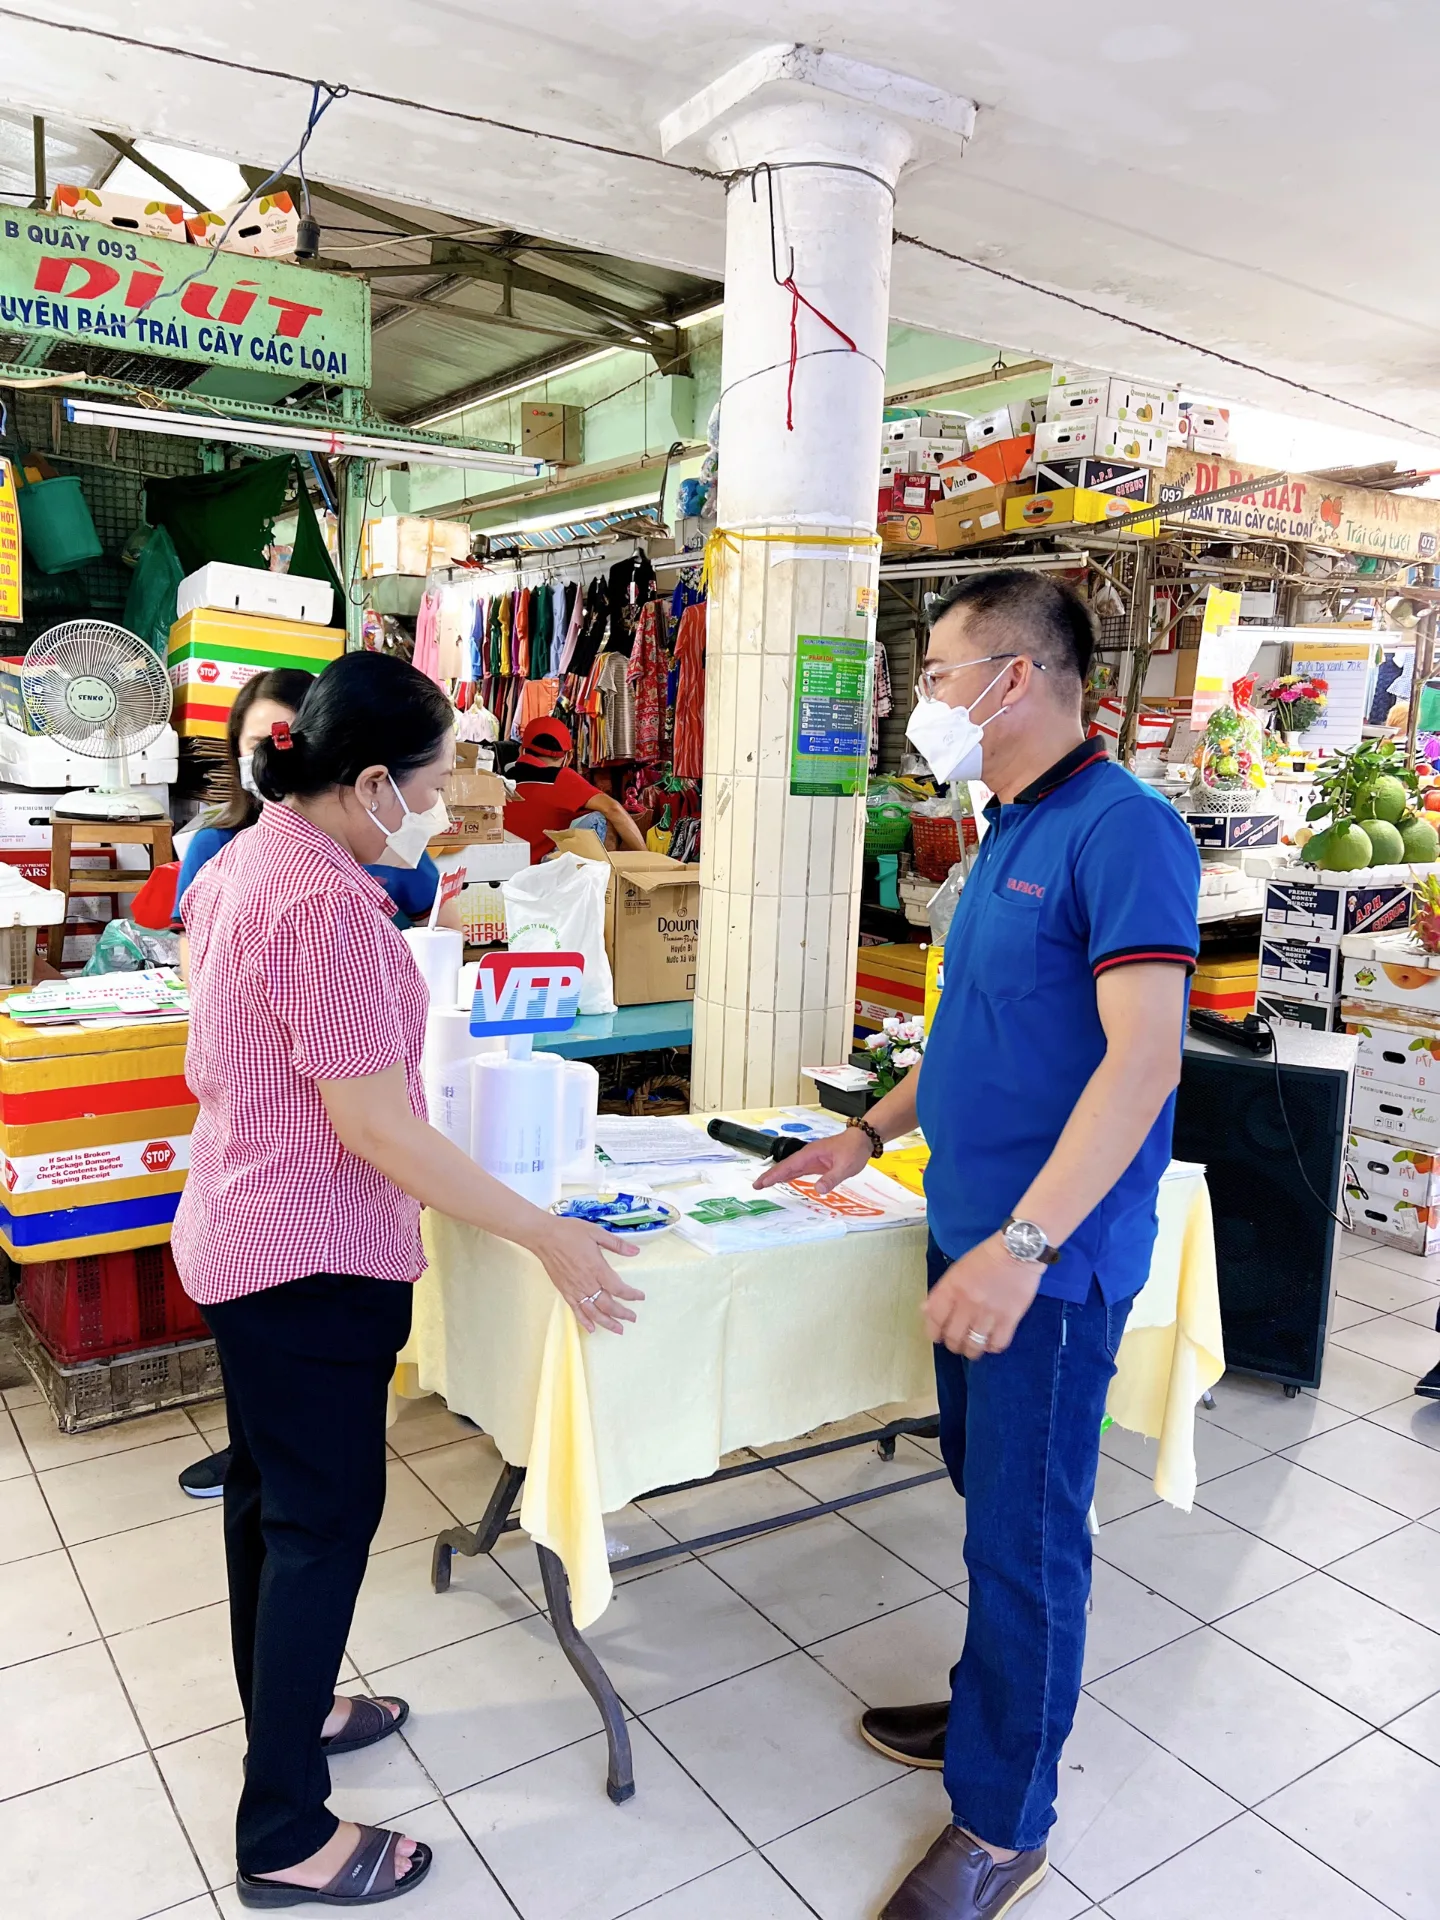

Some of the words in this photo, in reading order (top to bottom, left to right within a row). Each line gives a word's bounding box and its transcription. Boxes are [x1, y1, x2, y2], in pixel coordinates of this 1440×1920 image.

[5, 219, 20, 238] B
[28, 224, 90, 252] QUẦY
[97, 239, 138, 261] 093
[33, 256, 165, 310] DÌ
[77, 304, 127, 339] BÁN
[134, 316, 188, 349] TRÁI
[198, 326, 243, 357] CÂY
[250, 334, 294, 366] CÁC
[300, 345, 347, 380] LOẠI
[1088, 396, 1094, 405] 6
[1075, 433, 1081, 442] 6
[1161, 488, 1182, 502] 092
[1217, 505, 1242, 525] TRÁI
[1245, 508, 1266, 530] CÂY
[1267, 512, 1287, 533] CÁC
[1420, 535, 1436, 550] 073
[200, 667, 217, 677] STOP
[78, 694, 104, 702] SENKO
[19, 867, 48, 877] EARS
[1288, 889, 1318, 897] PREMIUM
[1291, 894, 1314, 902] HONEY
[462, 922, 507, 932] CITRU
[464, 931, 508, 942] CITRU
[1282, 946, 1311, 954] PREMIUM
[478, 966, 584, 1022] VFP
[1361, 1069, 1374, 1077] SET
[1418, 1076, 1426, 1086] B
[1360, 1085, 1383, 1095] PREMIUM
[1384, 1091, 1403, 1099] MELON
[56, 1155, 74, 1163] Seal
[83, 1150, 111, 1159] Broken
[146, 1150, 171, 1165] STOP
[39, 1165, 49, 1173] Or
[50, 1160, 84, 1171] Package
[85, 1156, 121, 1166] Damaged
[36, 1170, 62, 1180] Check
[63, 1166, 98, 1177] Contents
[99, 1162, 124, 1172] Before
[51, 1175, 80, 1185] Signing
[81, 1171, 110, 1181] Receipt
[1402, 1188, 1409, 1198] B
[1370, 1227, 1377, 1236] B
